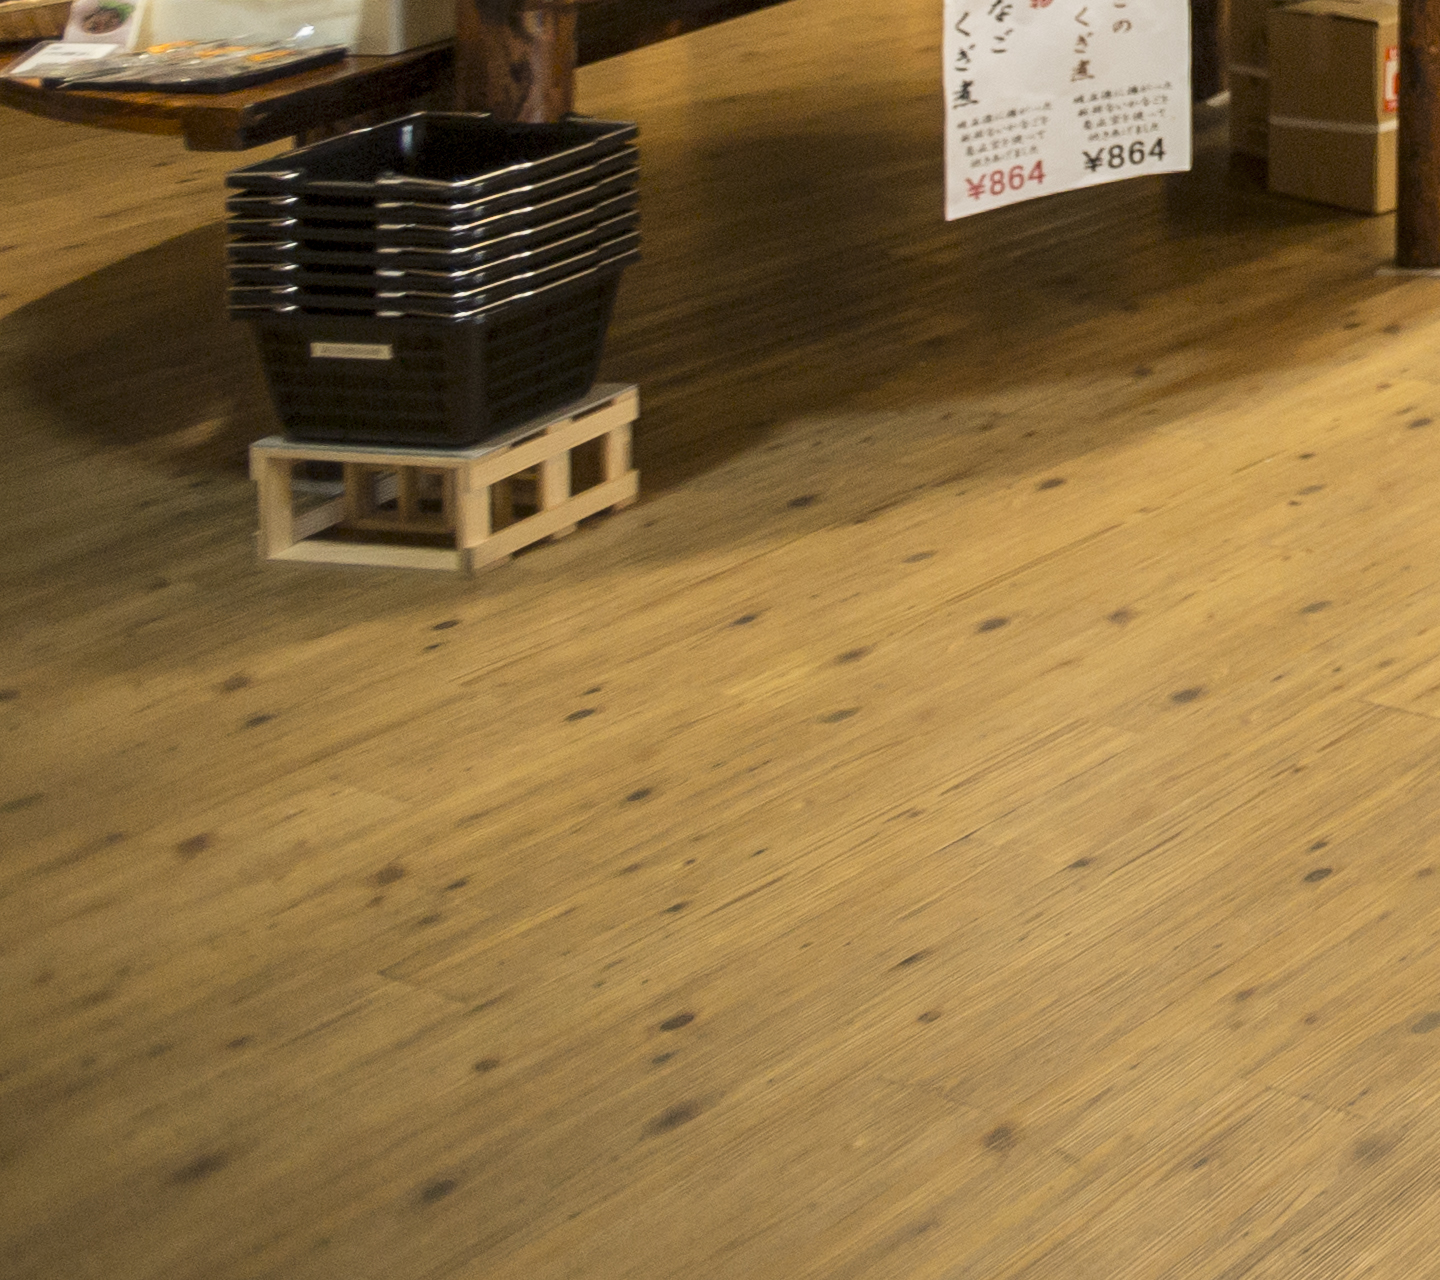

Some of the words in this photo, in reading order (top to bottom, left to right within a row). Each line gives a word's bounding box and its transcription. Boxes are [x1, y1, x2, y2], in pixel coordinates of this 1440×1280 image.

[952, 11, 980, 110] くぎ煮
[1070, 6, 1095, 83] くぎ煮
[965, 160, 1047, 200] ¥864
[1082, 137, 1167, 173] ¥864
